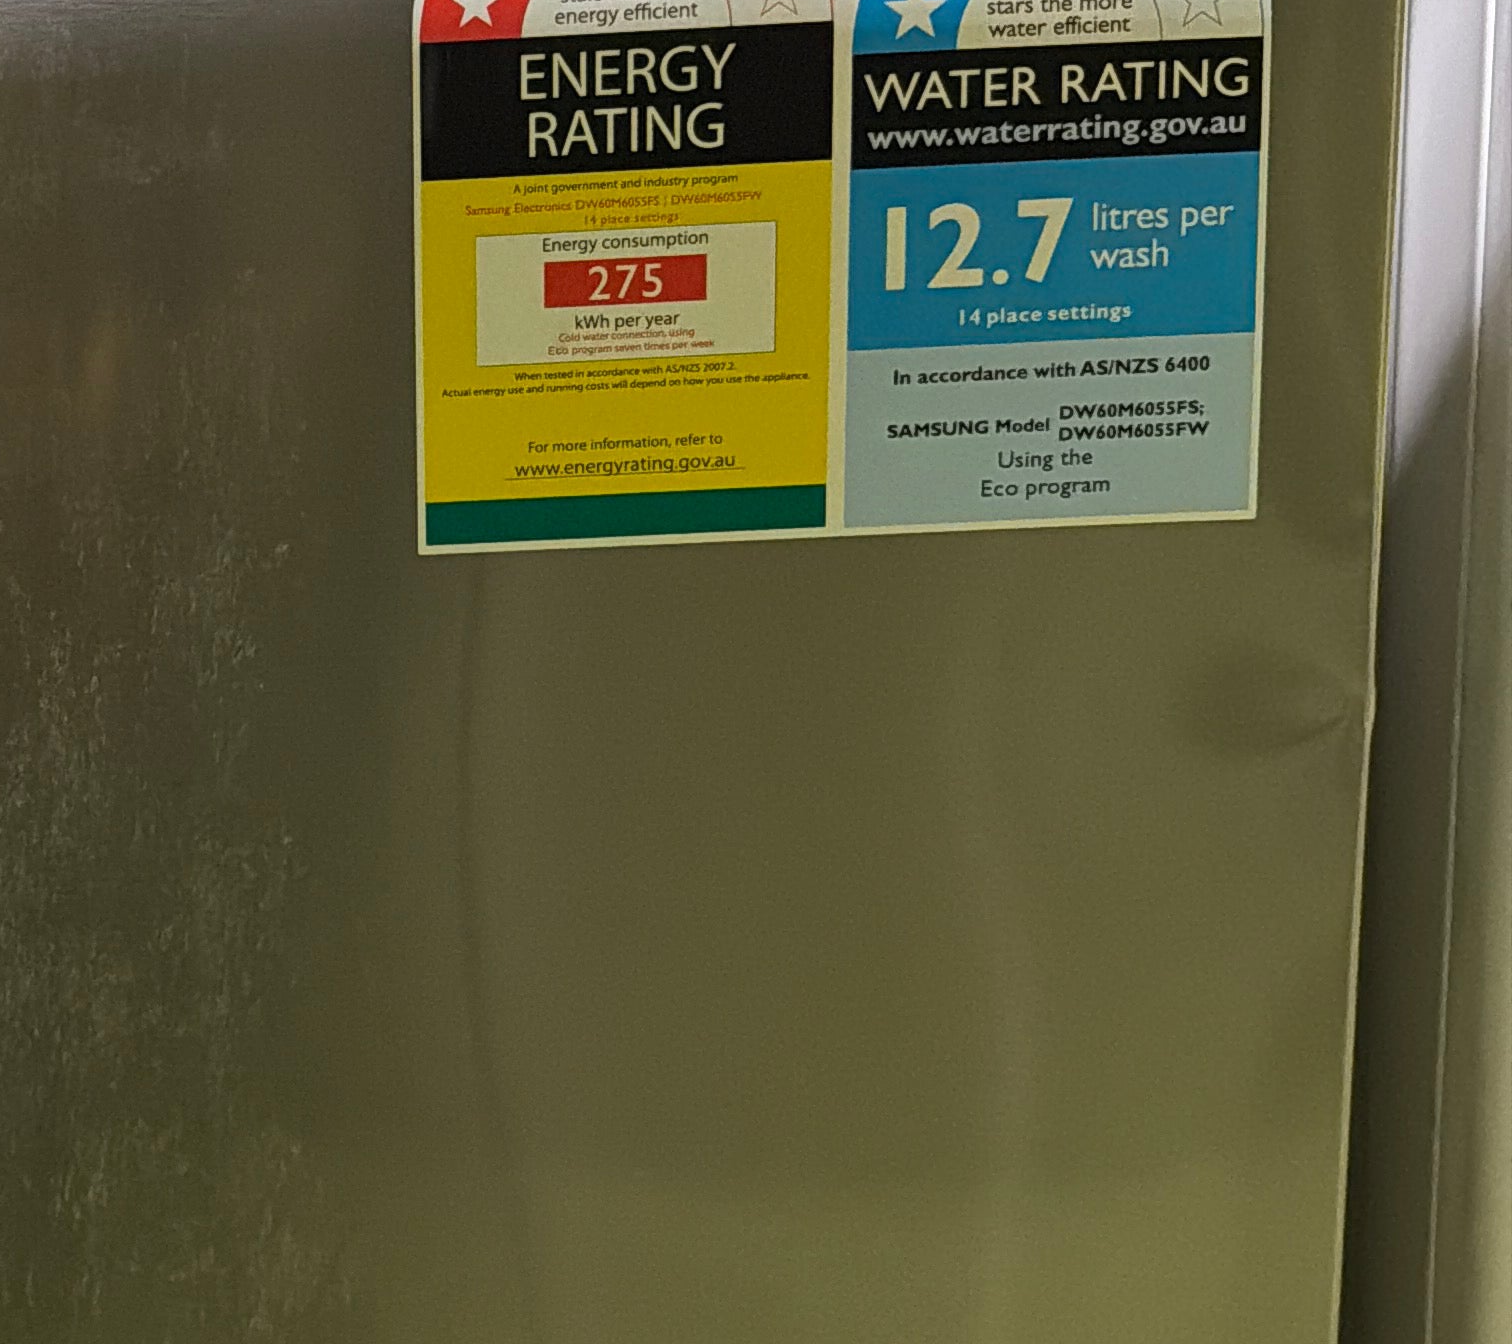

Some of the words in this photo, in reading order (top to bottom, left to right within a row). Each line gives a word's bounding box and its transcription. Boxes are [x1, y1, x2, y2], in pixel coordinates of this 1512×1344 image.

[554, 8, 619, 27] energy
[623, 2, 698, 20] efficient
[986, 0, 1034, 15] stars
[988, 21, 1048, 38] water
[1053, 15, 1131, 35] efficient
[519, 43, 737, 101] ENERGY
[864, 65, 1041, 113] WATER
[1061, 57, 1250, 105] RATING
[528, 102, 725, 158] RATING
[867, 113, 1247, 150] www.waterrating.gov.au
[513, 184, 521, 194] A
[523, 184, 548, 196] joint
[551, 180, 618, 195] government
[620, 178, 641, 189] and
[643, 176, 689, 188] industry
[691, 174, 738, 187] program
[465, 205, 511, 216] Samsung
[513, 201, 572, 214] Electronics
[600, 213, 630, 226] place
[634, 212, 679, 224] settings
[1092, 201, 1169, 231] litres
[1180, 203, 1235, 237] per
[543, 237, 597, 254] Energy
[602, 231, 709, 249] consumption
[885, 197, 1074, 291] 12.7
[1090, 238, 1169, 270] wash
[589, 263, 663, 301] 275
[575, 314, 609, 330] kWh
[615, 315, 644, 331] per
[645, 313, 680, 330] year
[958, 307, 981, 326] 14
[986, 305, 1042, 328] place
[1047, 302, 1132, 324] settings
[558, 333, 580, 343] Cold
[583, 331, 609, 342] water
[611, 329, 666, 340] connection,
[669, 328, 695, 339] using
[548, 346, 569, 355] Eco
[572, 344, 612, 356] program
[614, 343, 641, 352] seven
[643, 341, 670, 351] times
[672, 341, 687, 351] per
[690, 340, 715, 348] week
[514, 372, 542, 381] When
[544, 370, 573, 380] tested
[575, 369, 584, 378] in
[587, 366, 640, 378] accordance
[642, 362, 663, 373] with
[893, 369, 911, 385] In
[917, 365, 1028, 384] accordance
[1034, 361, 1076, 378] with
[1079, 357, 1159, 377] AS/NZS
[1165, 356, 1211, 373] 6400
[442, 388, 472, 398] Actual
[473, 387, 506, 398] energy
[508, 386, 524, 395] use
[526, 384, 544, 394] and
[546, 382, 584, 394] running
[585, 381, 610, 391] costs
[611, 379, 628, 389] will
[630, 378, 666, 389] depend
[669, 378, 681, 387] on
[683, 375, 704, 386] how
[706, 376, 724, 387] you
[726, 375, 742, 384] use
[744, 373, 760, 383] the
[1059, 399, 1205, 420] DW60M6055FS;
[887, 419, 989, 439] SAMSUNG
[995, 417, 1050, 434] Model
[1058, 420, 1210, 442] DW60M6055FW
[527, 440, 548, 453] For
[552, 440, 587, 452] more
[590, 435, 671, 450] information,
[675, 433, 706, 447] refer
[709, 433, 723, 445] to
[514, 454, 736, 477] www.energyrating.gov.au
[998, 450, 1054, 472] Using
[1061, 448, 1094, 466] the
[980, 479, 1019, 498] Eco
[1025, 479, 1110, 501] program
